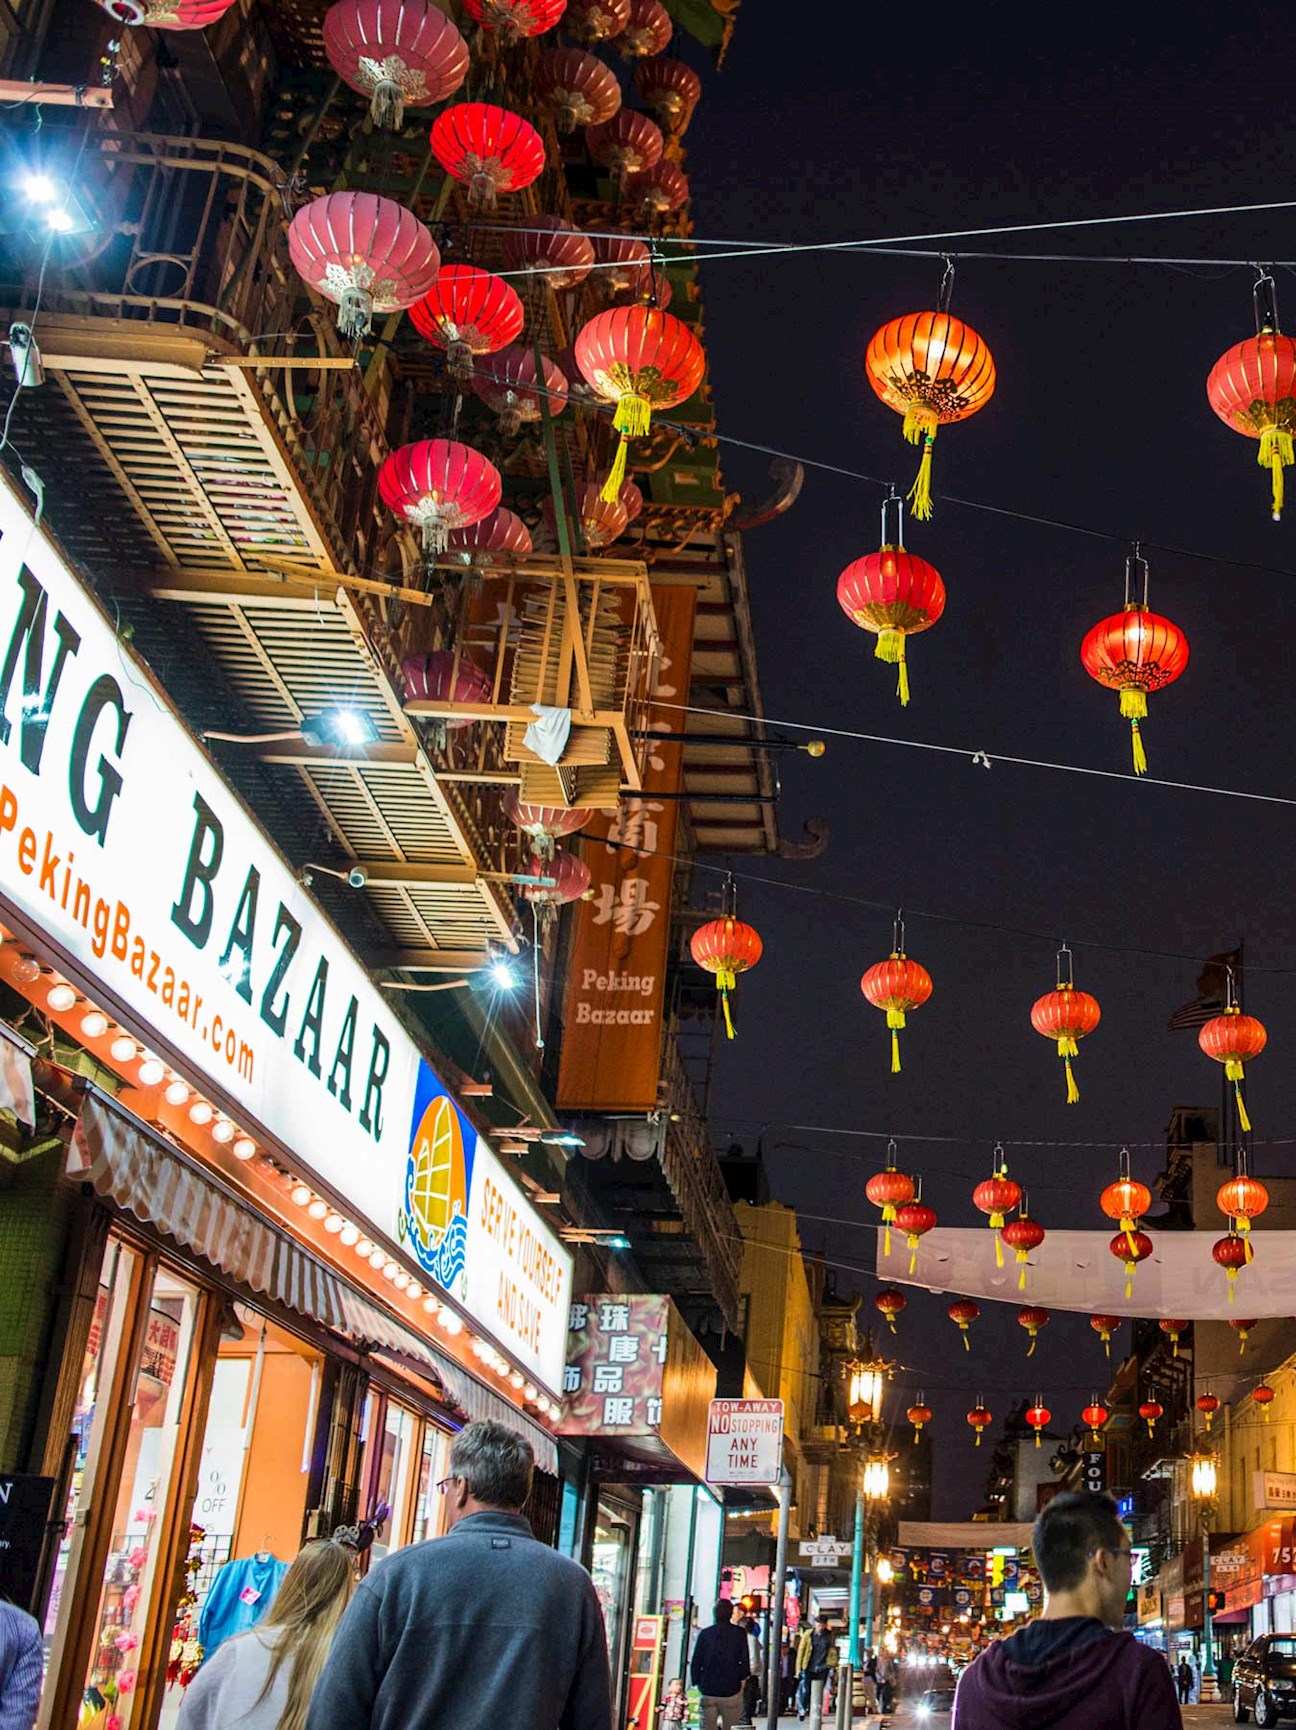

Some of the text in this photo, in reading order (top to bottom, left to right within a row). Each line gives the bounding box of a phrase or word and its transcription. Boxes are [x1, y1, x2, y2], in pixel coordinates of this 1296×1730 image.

[0, 560, 392, 1144] NG BAZAAR
[0, 784, 256, 1086] PekingBazaar.com
[582, 968, 655, 996] Peking
[576, 1002, 655, 1026] Bazaar
[481, 1176, 564, 1306] SERVE YOURSELF
[497, 1270, 542, 1354] AND SAVE
[714, 1401, 779, 1413] TOW-AWAY
[710, 1413, 778, 1434] NO STOPPING
[730, 1437, 758, 1451] ANY
[727, 1454, 758, 1469] TIME
[202, 1497, 228, 1513] OFF
[805, 1544, 847, 1554] CLAY
